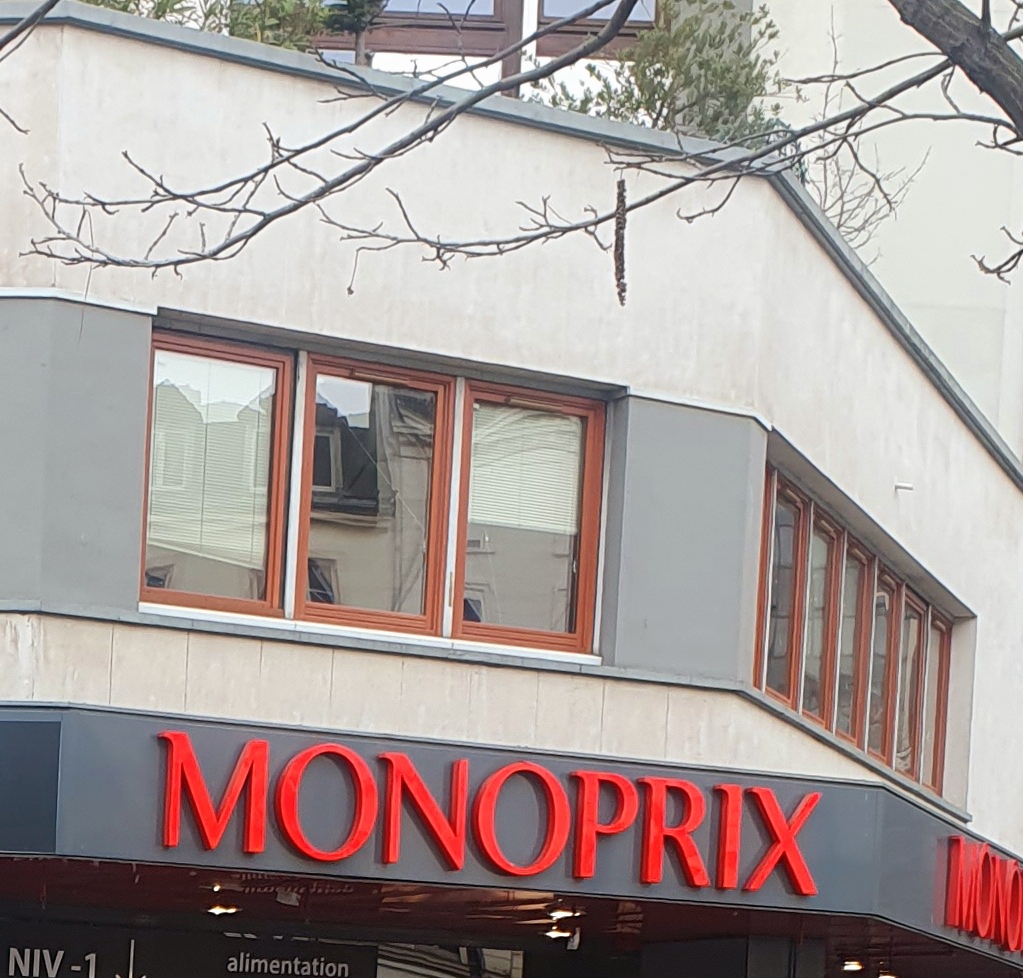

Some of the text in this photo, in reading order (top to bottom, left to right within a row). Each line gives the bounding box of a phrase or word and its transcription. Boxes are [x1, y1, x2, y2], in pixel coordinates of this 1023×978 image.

[157, 729, 822, 896] MONOPRIX
[945, 834, 1023, 951] MONO
[227, 952, 349, 978] alimentation
